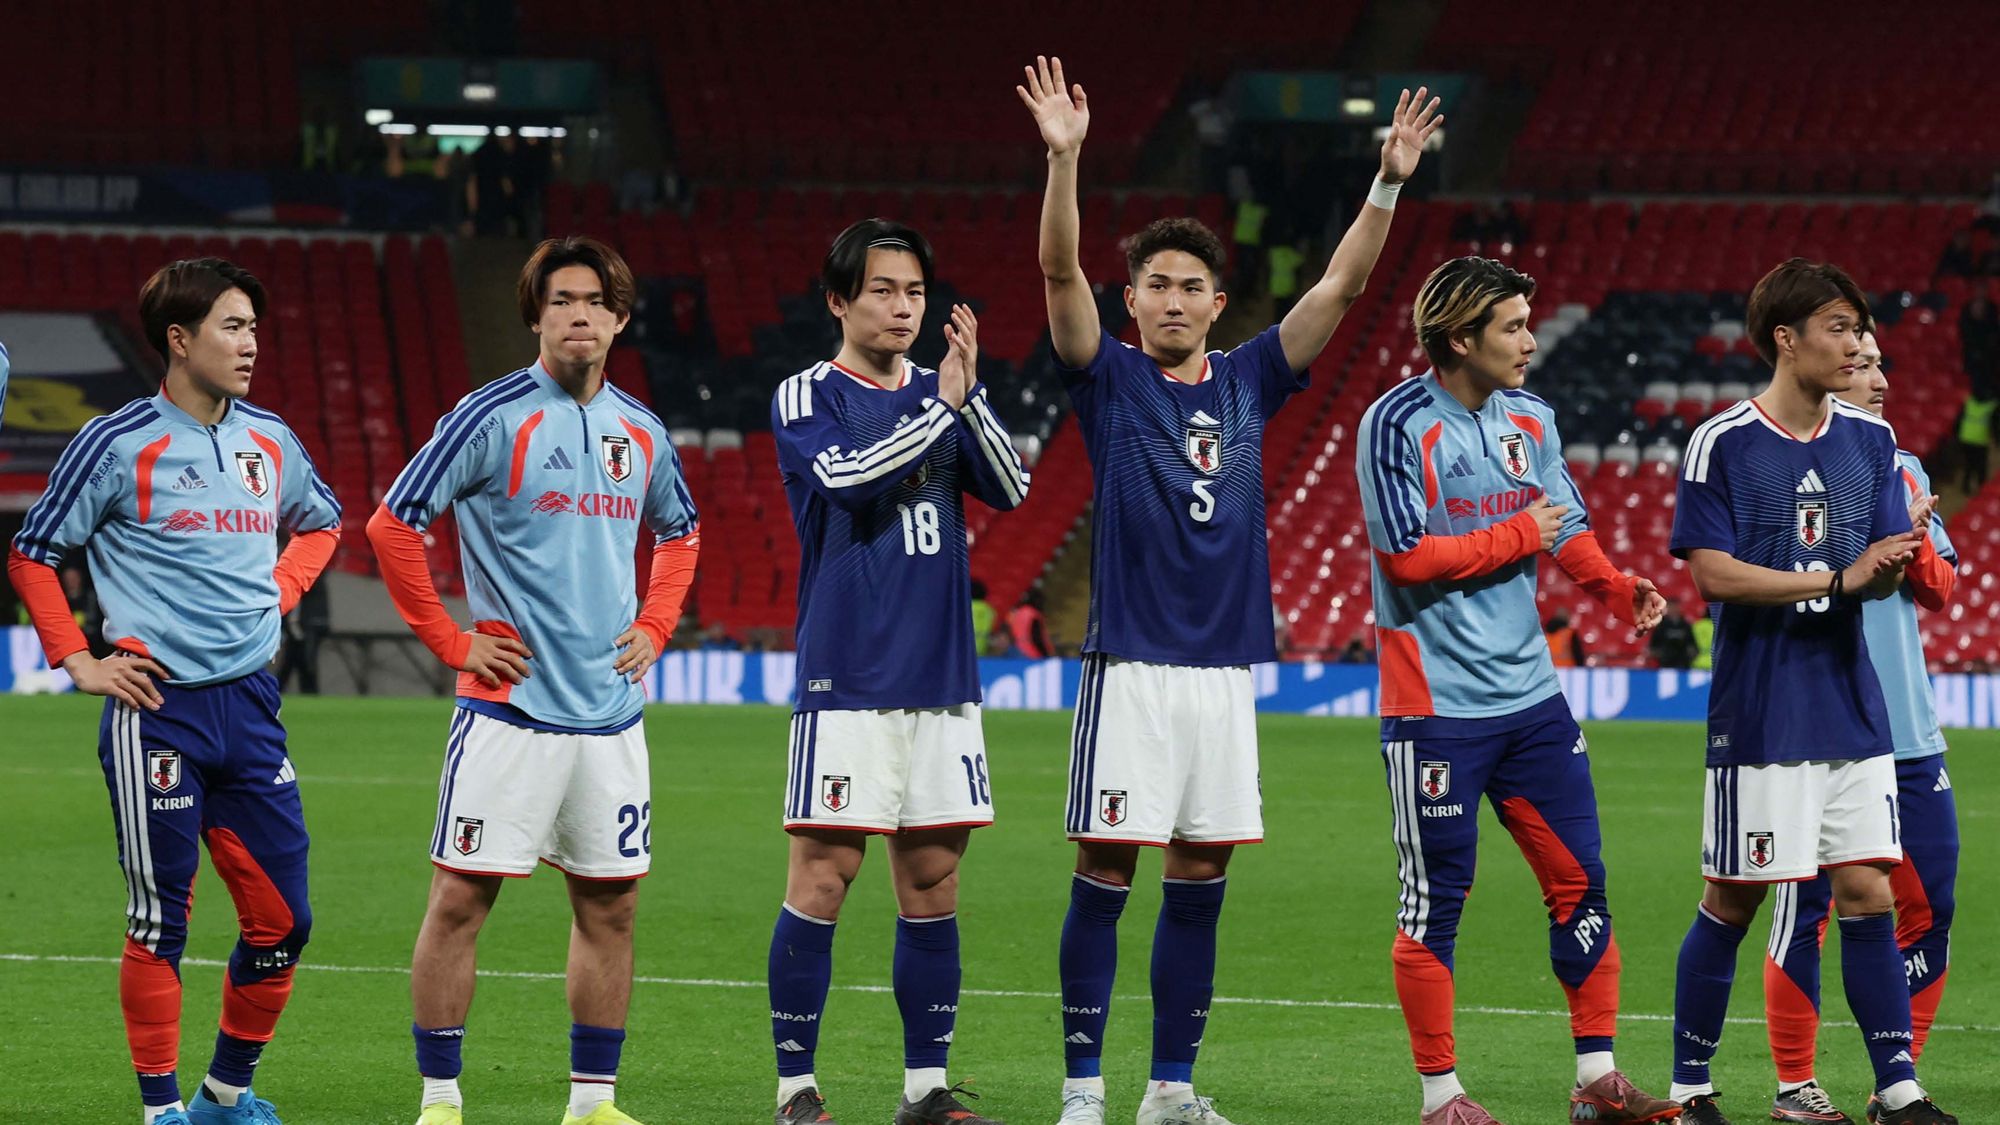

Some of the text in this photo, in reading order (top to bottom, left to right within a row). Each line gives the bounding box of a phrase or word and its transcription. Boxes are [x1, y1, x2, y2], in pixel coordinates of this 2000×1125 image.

[577, 493, 638, 521] KIRIN
[896, 502, 941, 556] 18
[961, 753, 990, 806] 18
[152, 795, 194, 810] KIRIN
[1421, 804, 1463, 818] KIRIN
[1573, 908, 1604, 954] JPN
